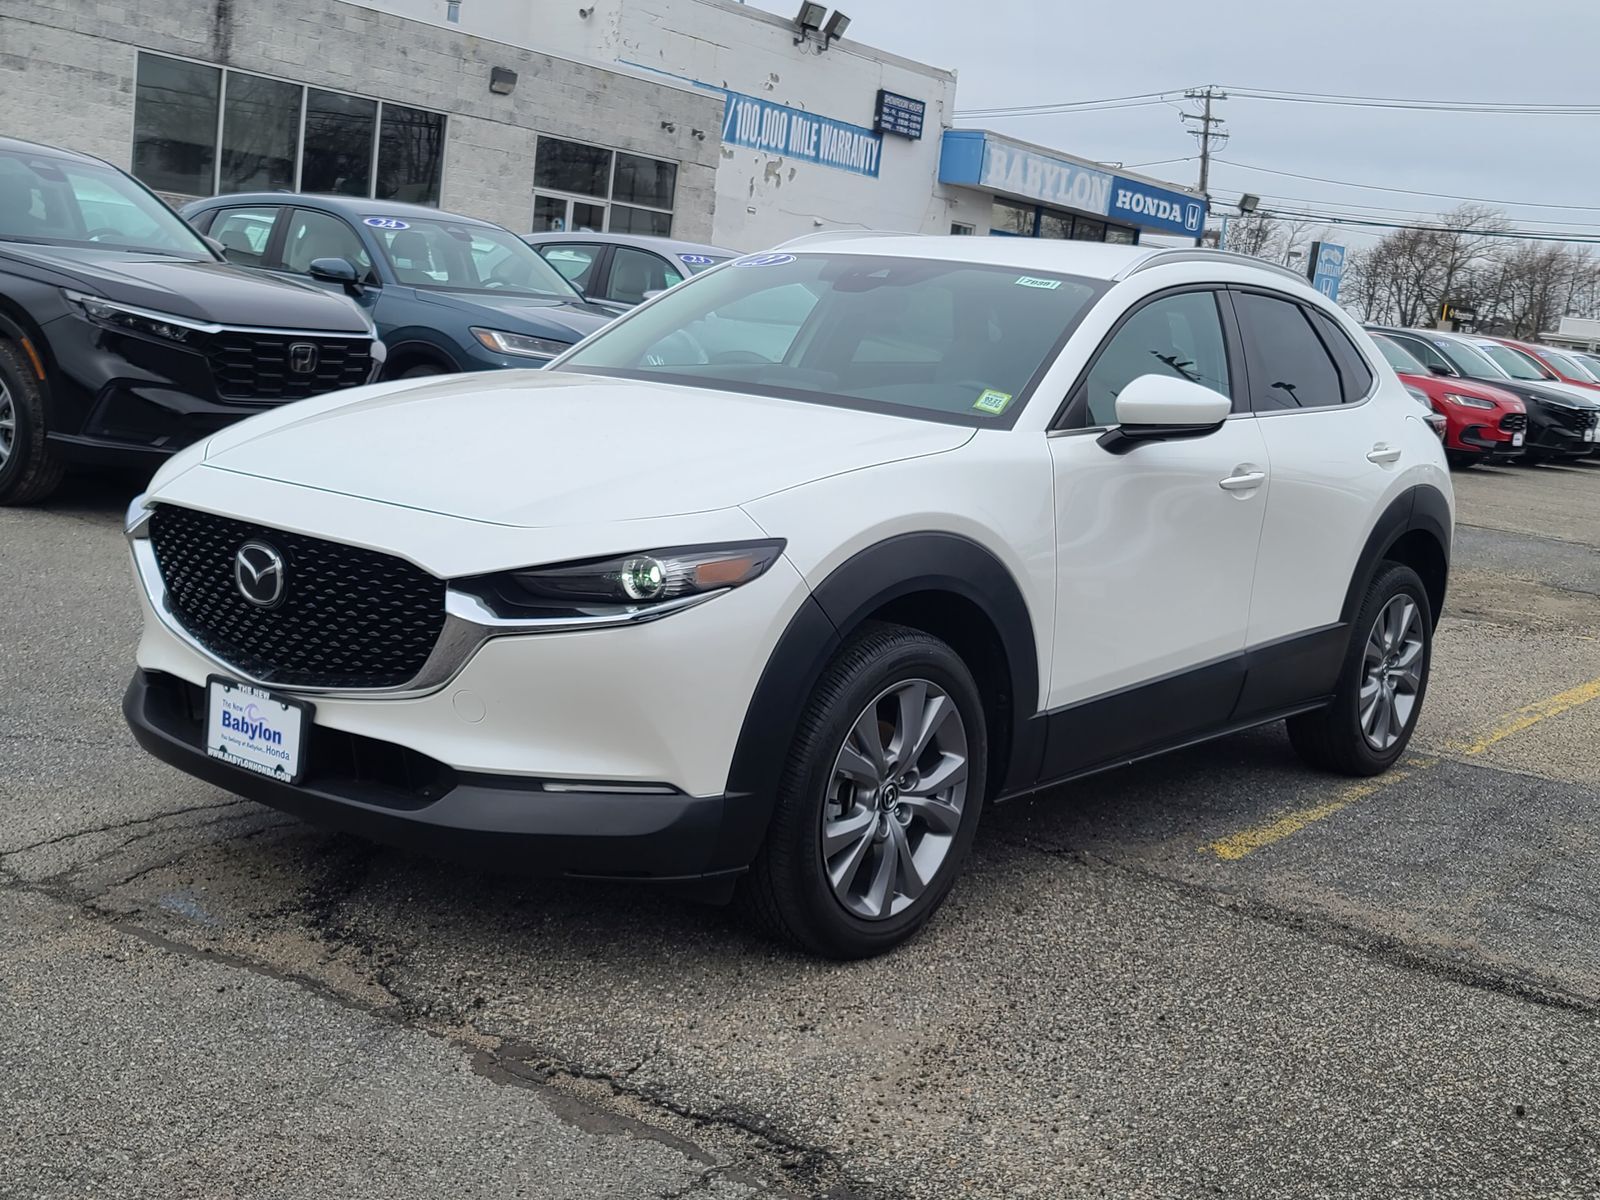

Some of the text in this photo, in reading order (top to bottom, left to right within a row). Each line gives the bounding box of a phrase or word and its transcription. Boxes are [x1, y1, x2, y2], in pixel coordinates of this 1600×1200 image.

[789, 114, 819, 157] MILE
[819, 123, 880, 171] WARRANTY
[987, 149, 1182, 223] BABYLON HONDA
[237, 683, 270, 700] THE NEW
[222, 710, 281, 744] Babylon
[265, 745, 290, 760] Honda
